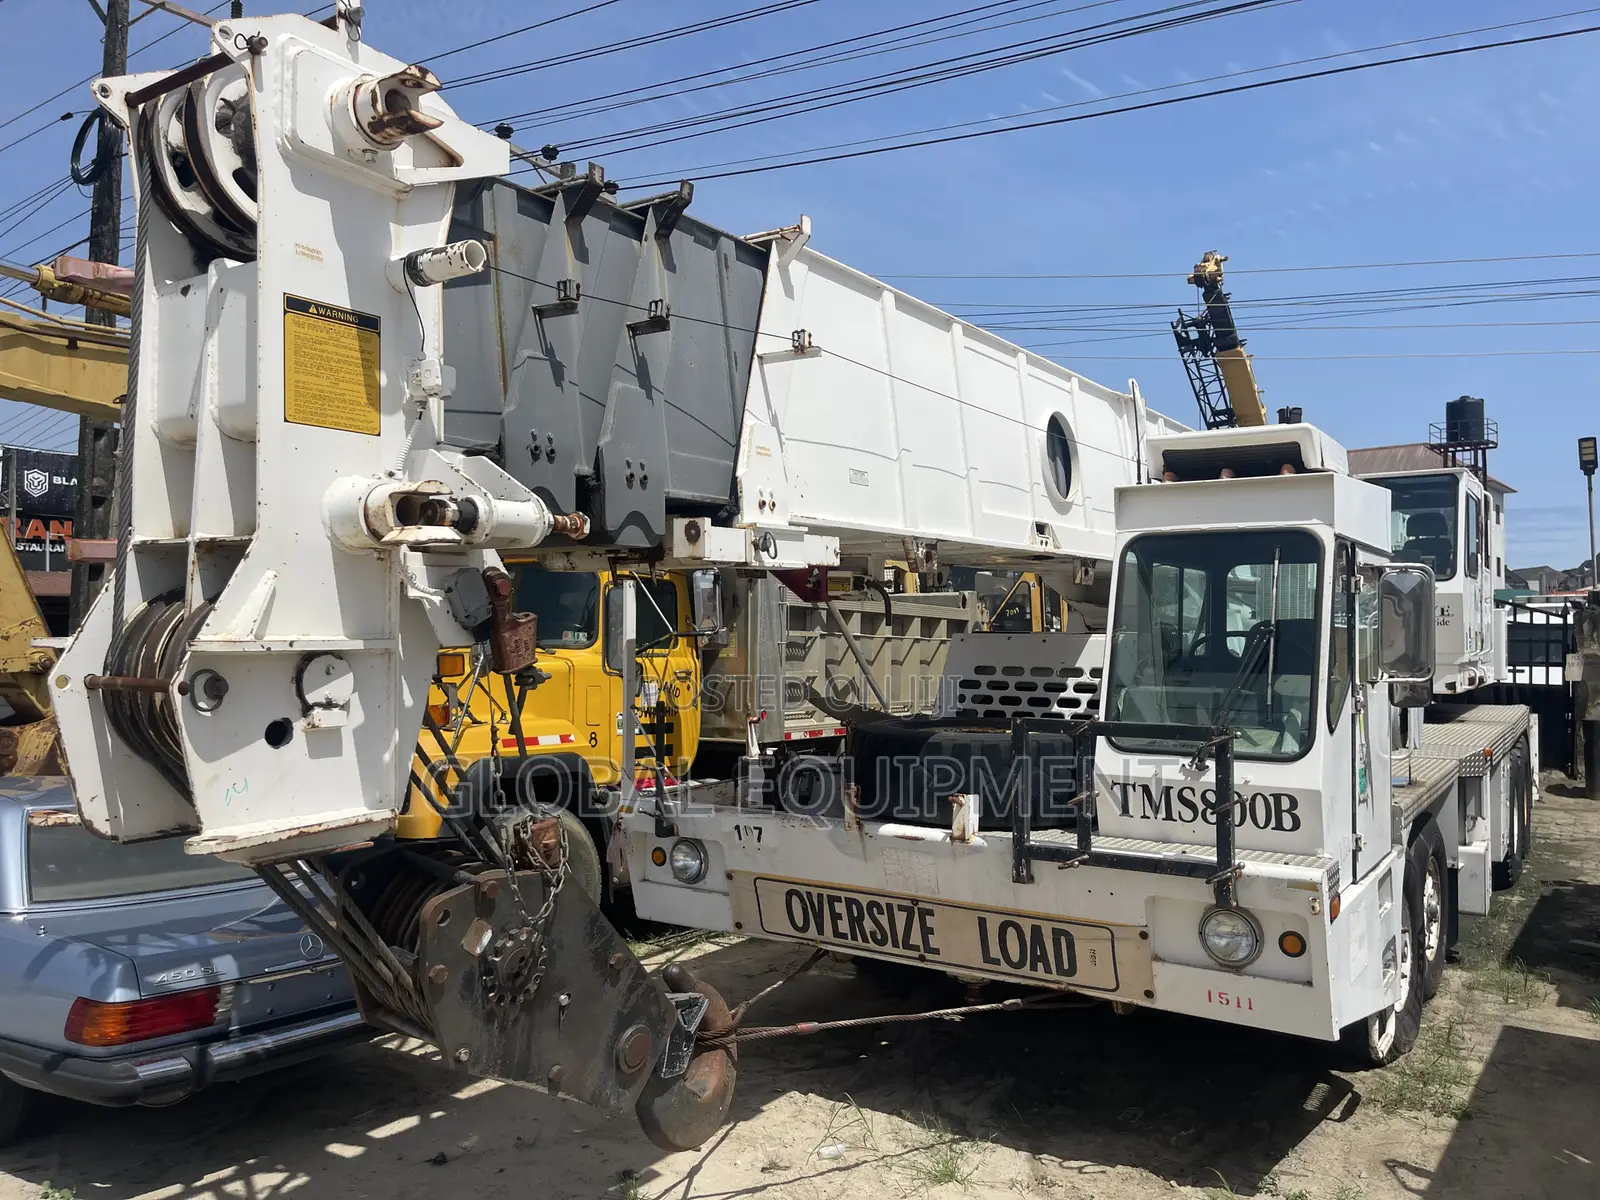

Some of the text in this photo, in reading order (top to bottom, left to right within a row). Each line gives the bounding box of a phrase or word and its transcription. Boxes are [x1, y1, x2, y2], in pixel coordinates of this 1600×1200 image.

[317, 306, 359, 323] WARNING
[589, 732, 598, 748] 8
[785, 888, 1078, 978] OVERSIZE LOAD
[157, 969, 196, 983] 450
[1207, 989, 1254, 1011] 1511
